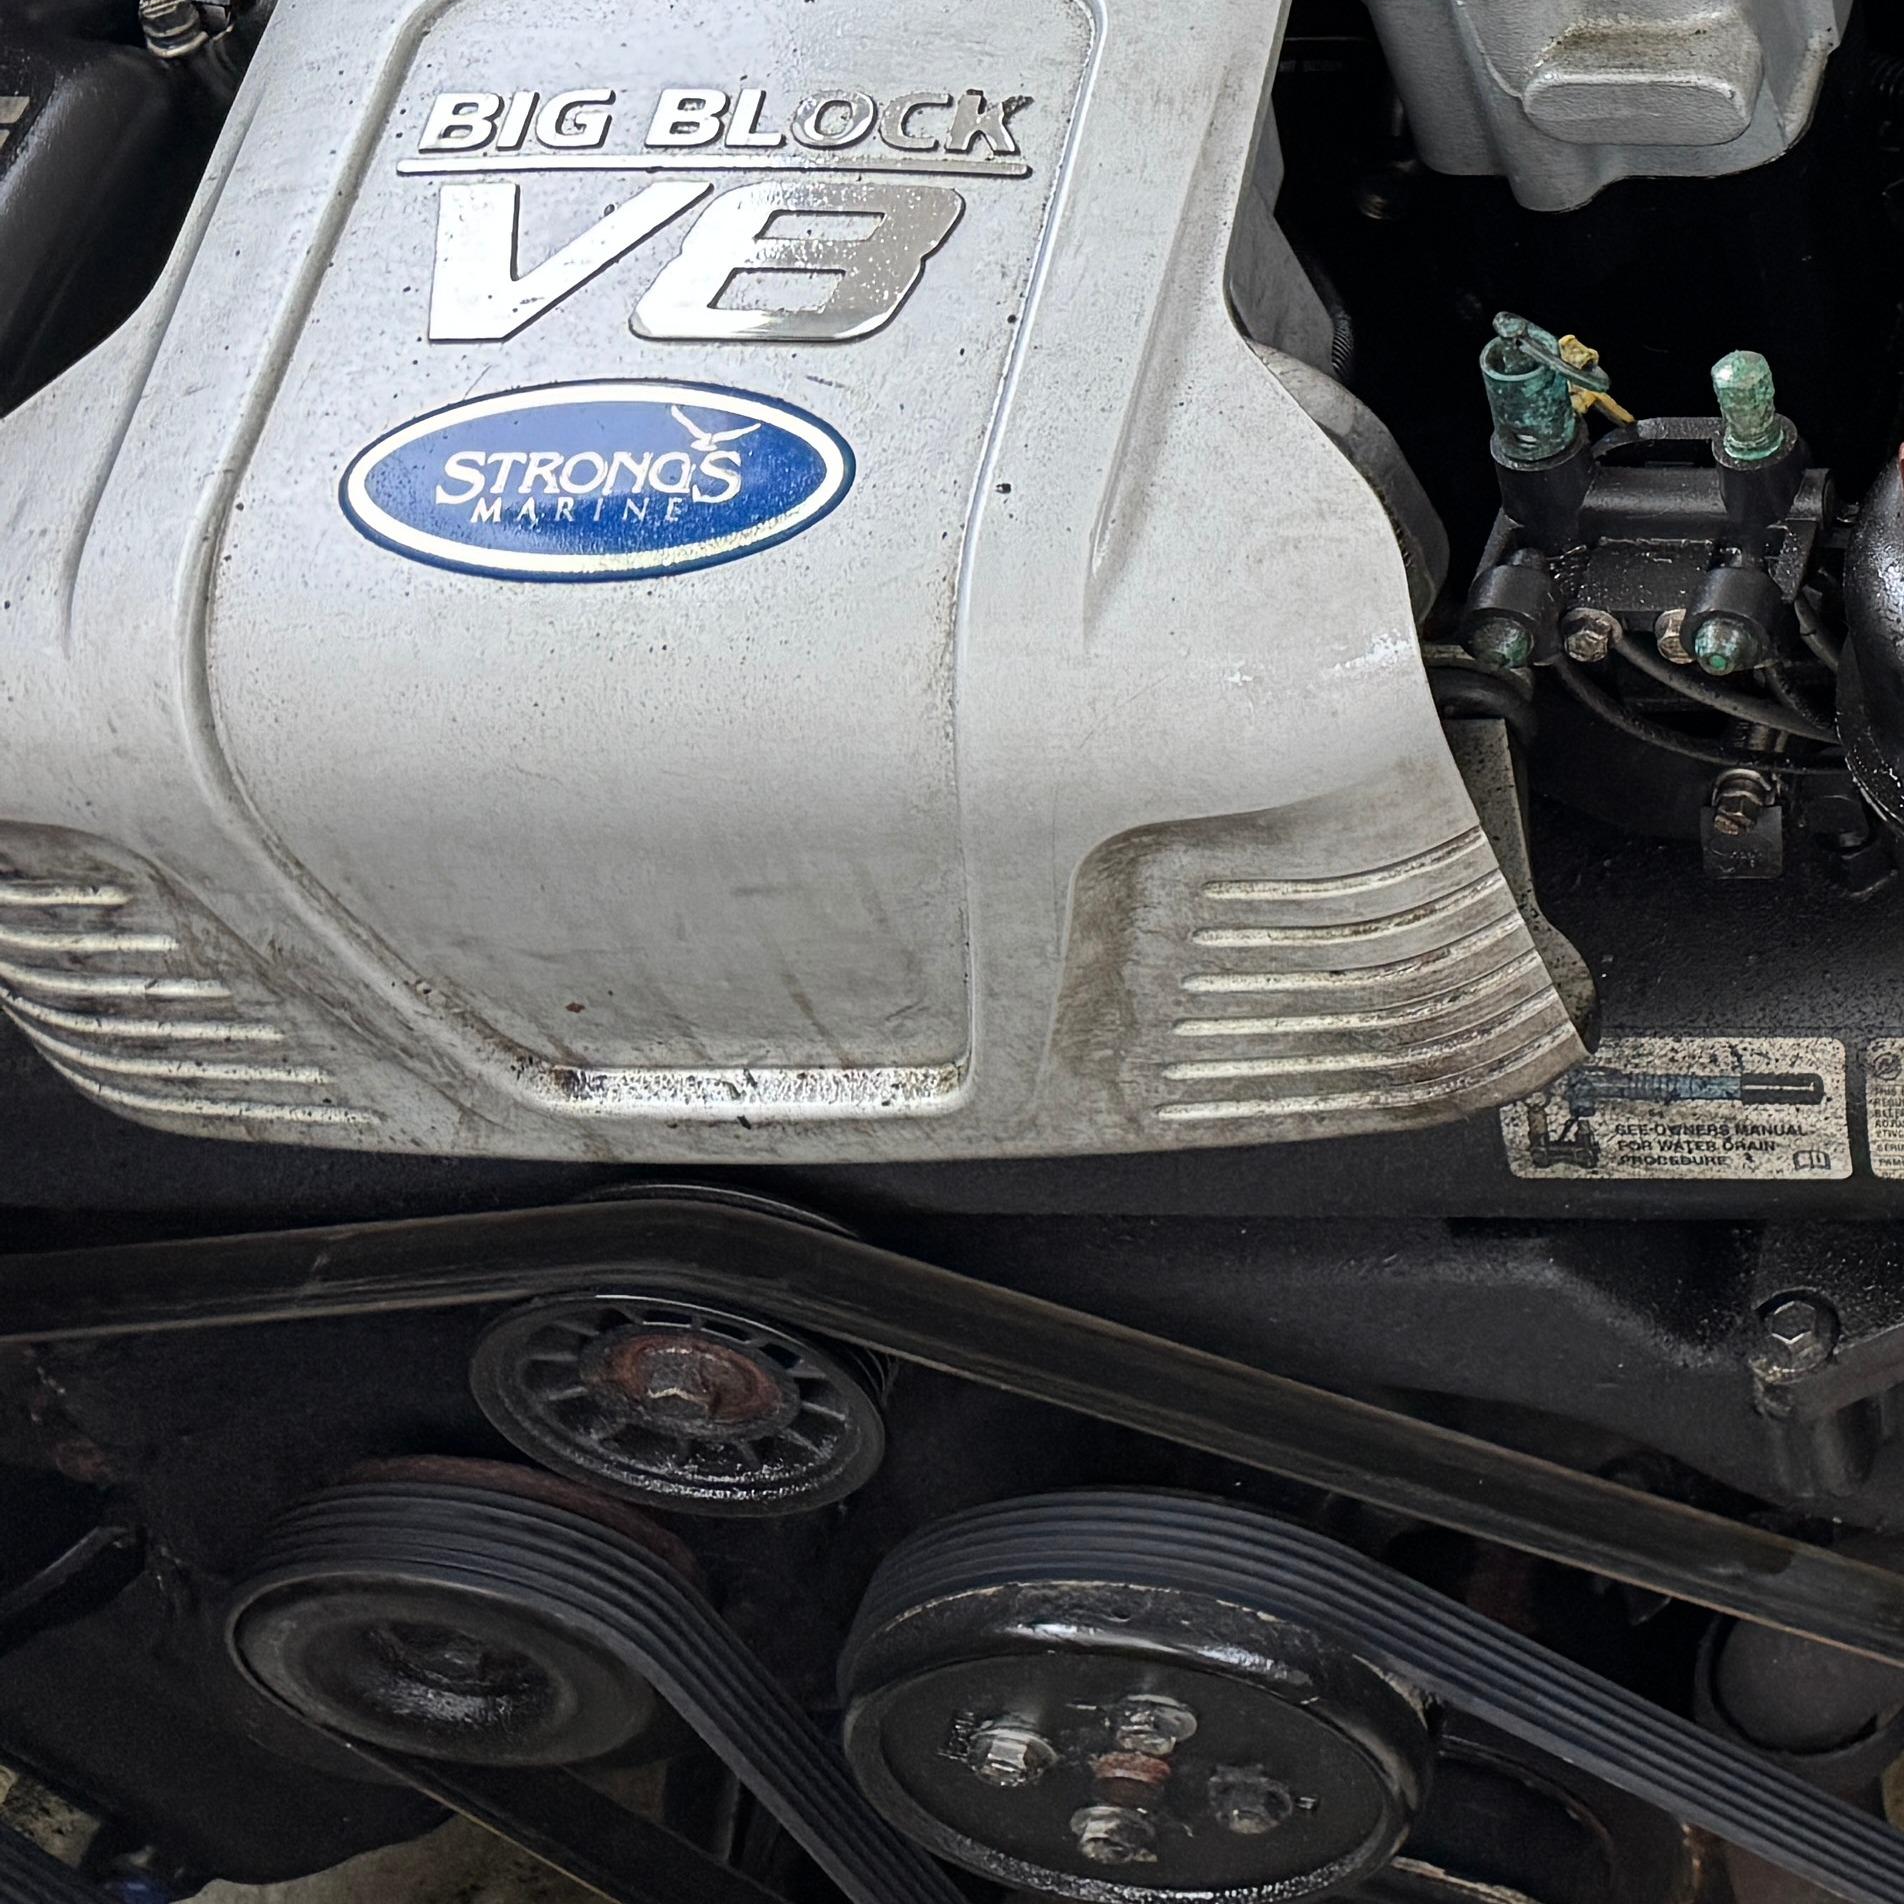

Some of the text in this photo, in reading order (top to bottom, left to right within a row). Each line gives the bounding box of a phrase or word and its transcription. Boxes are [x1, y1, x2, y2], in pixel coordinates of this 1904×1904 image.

[418, 88, 1036, 156] BIG BLOCK
[428, 180, 968, 343] V8
[470, 497, 683, 524] MARINE
[1653, 1123, 1732, 1138] OWNERS
[1734, 1123, 1808, 1138] MANUAL
[1617, 1138, 1777, 1154] FOR WATER DRAIN
[1617, 1154, 1730, 1167] PROCEDURE
